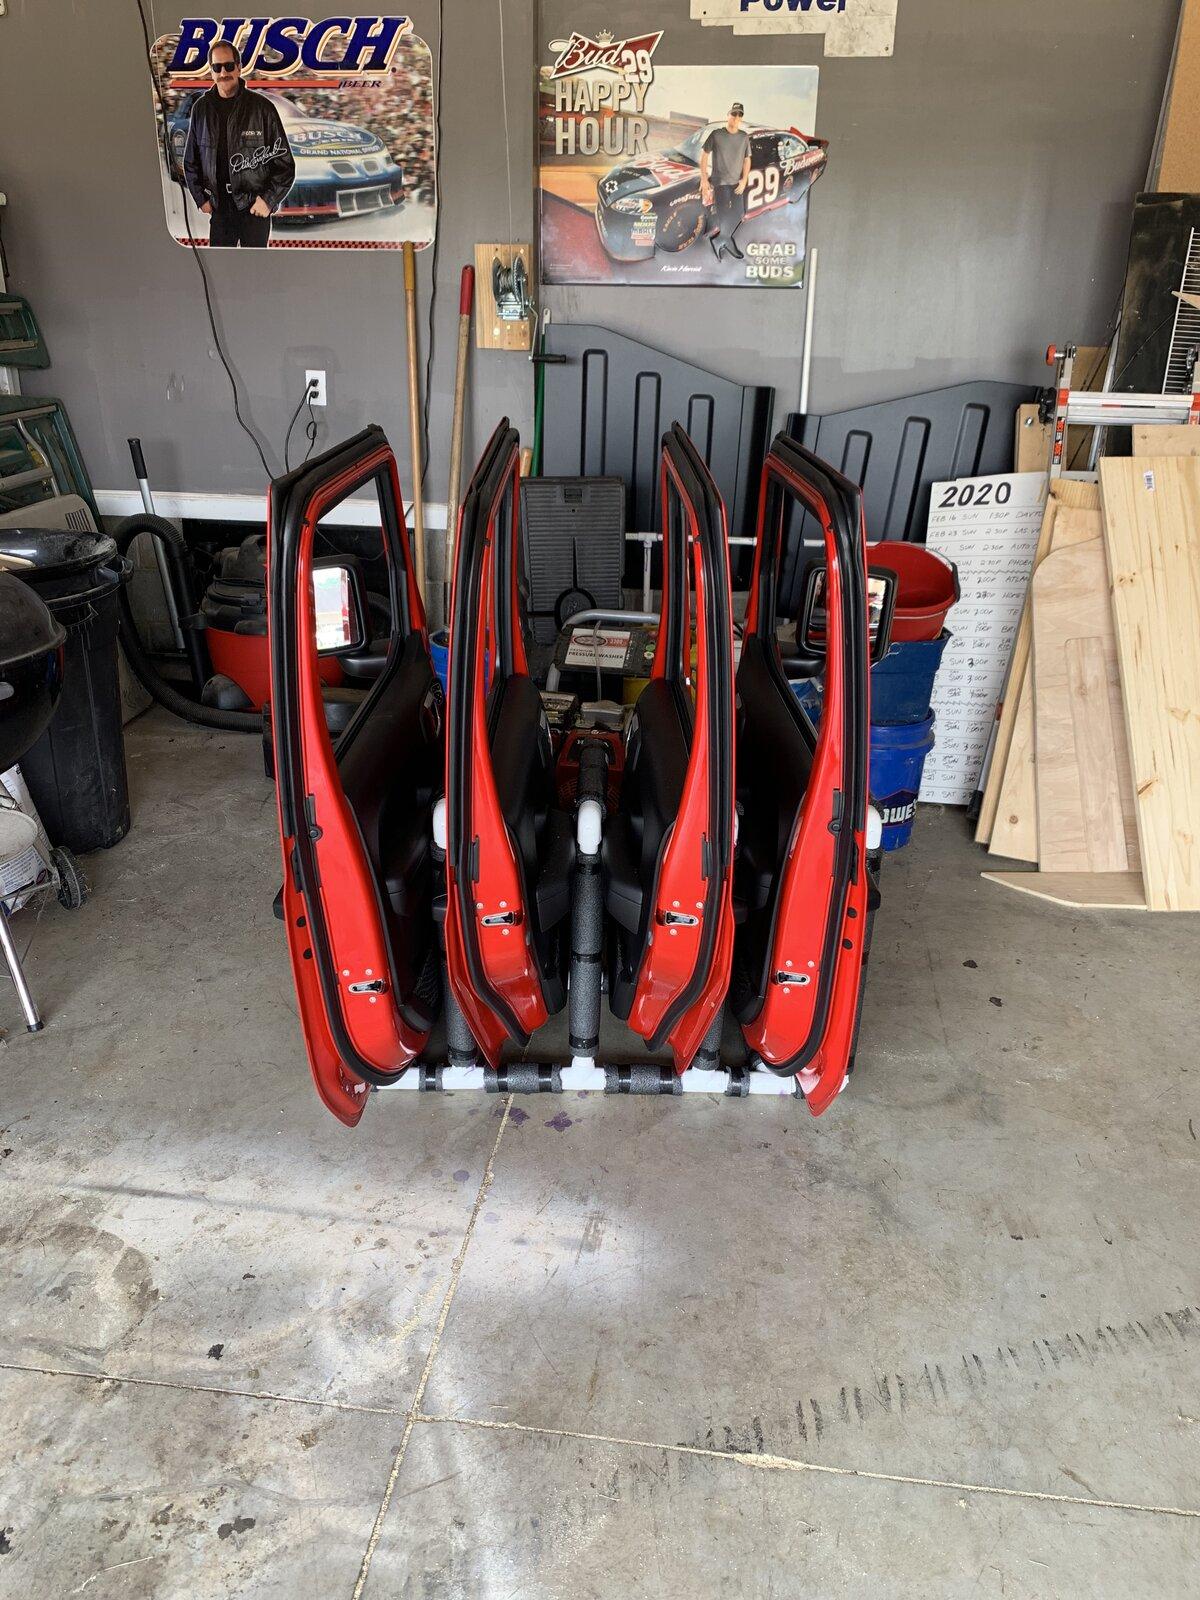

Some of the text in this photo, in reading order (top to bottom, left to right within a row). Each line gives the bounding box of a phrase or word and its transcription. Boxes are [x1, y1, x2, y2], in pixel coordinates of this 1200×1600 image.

[167, 16, 410, 75] BUSCH
[548, 39, 653, 83] Bud 29
[342, 80, 382, 88] BEER
[555, 80, 652, 112] HAPPY
[555, 116, 650, 156] HOUR
[300, 148, 329, 156] GRAND
[748, 166, 780, 210] 29
[746, 243, 796, 256] GRAB
[755, 256, 787, 265] SOME
[745, 265, 795, 279] BUDS
[938, 482, 1011, 508] 2020
[1008, 559, 1032, 567] PHOEN
